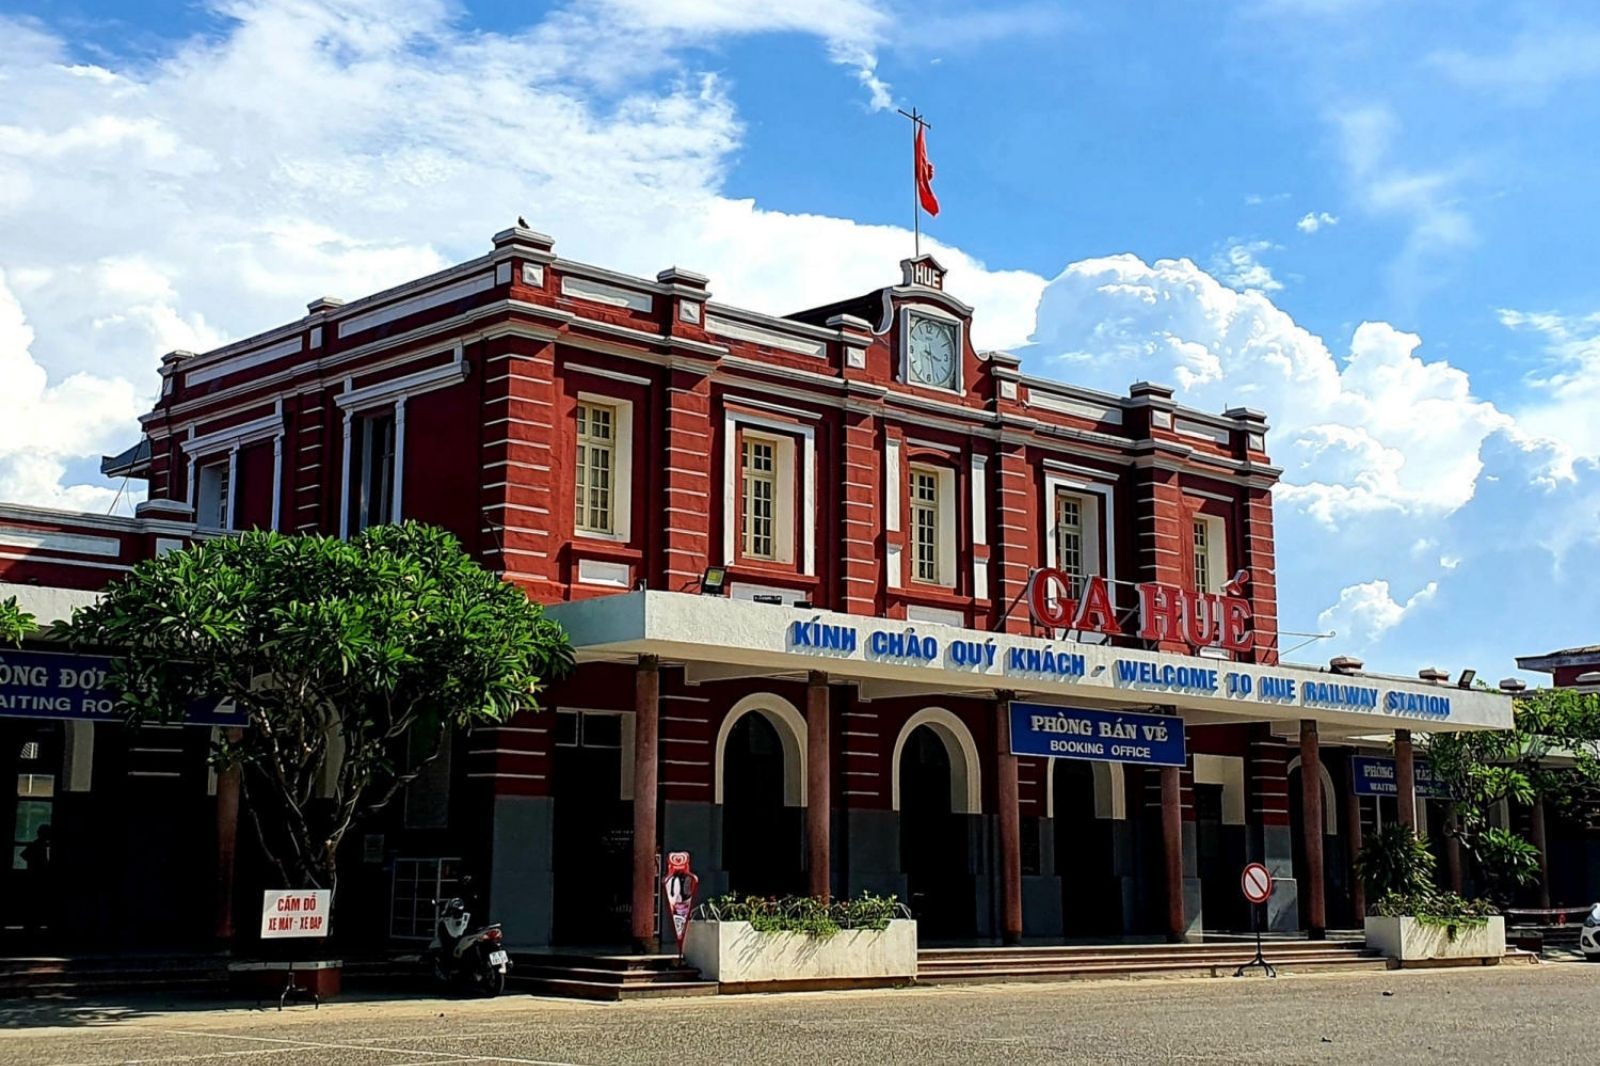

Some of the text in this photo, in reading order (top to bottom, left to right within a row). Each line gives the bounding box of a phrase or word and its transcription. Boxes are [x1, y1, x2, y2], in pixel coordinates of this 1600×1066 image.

[915, 264, 940, 288] HUE
[1027, 568, 1254, 651] GA HUẾ
[792, 614, 857, 652] KÍNH
[950, 637, 997, 666] QUÝ
[1008, 644, 1085, 677] KHÁCH
[1117, 659, 1219, 692] WELCOME
[1226, 671, 1252, 693] TO
[1259, 676, 1296, 700] HUE
[1303, 680, 1378, 707] RAILWAY
[1386, 690, 1450, 716] STATION
[1030, 711, 1169, 742] PHÒNG BÁN VÉ
[1050, 740, 1151, 758] BOOKING OFFICE
[268, 917, 277, 931] XE
[279, 913, 293, 930] MÁY
[300, 916, 309, 930] XE
